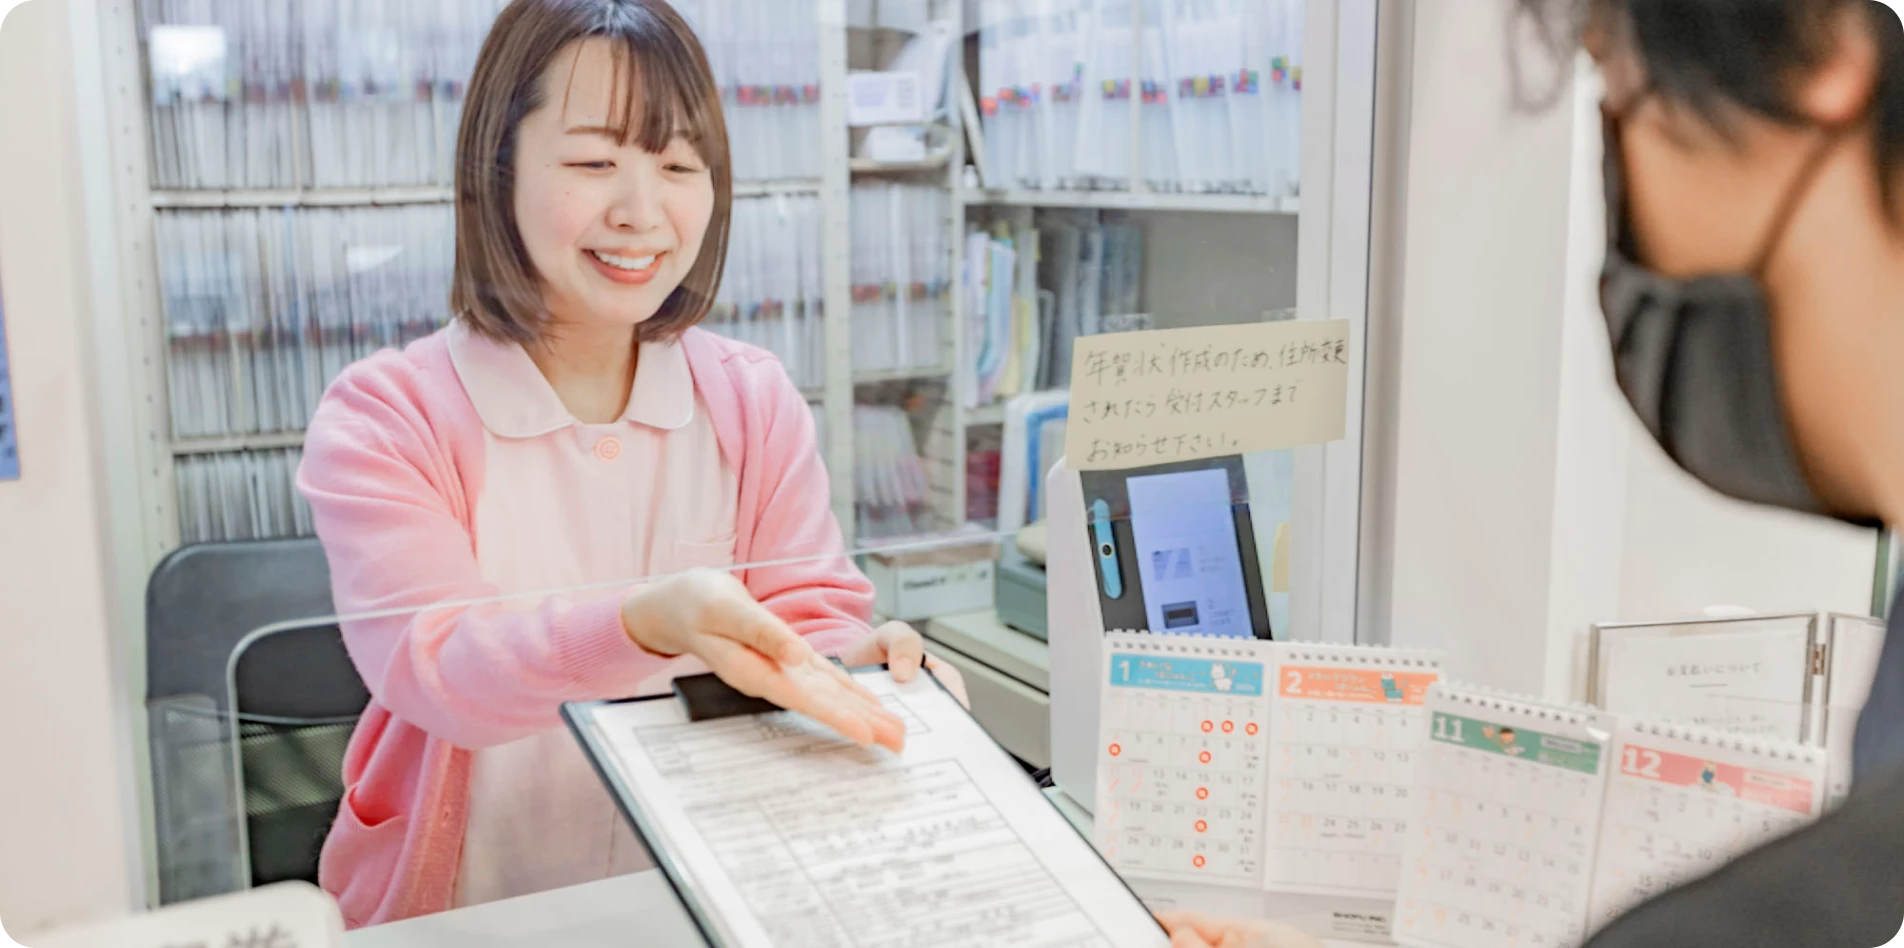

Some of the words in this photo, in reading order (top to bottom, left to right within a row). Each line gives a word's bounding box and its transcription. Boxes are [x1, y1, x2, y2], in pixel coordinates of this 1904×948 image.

[1118, 660, 1131, 682] 1
[1286, 670, 1304, 694] 2
[1433, 716, 1465, 743] 11
[1373, 751, 1386, 762] 12
[1623, 747, 1662, 778] 12
[1197, 772, 1211, 783] 15
[1129, 800, 1142, 812] 19
[1639, 875, 1654, 887] 15
